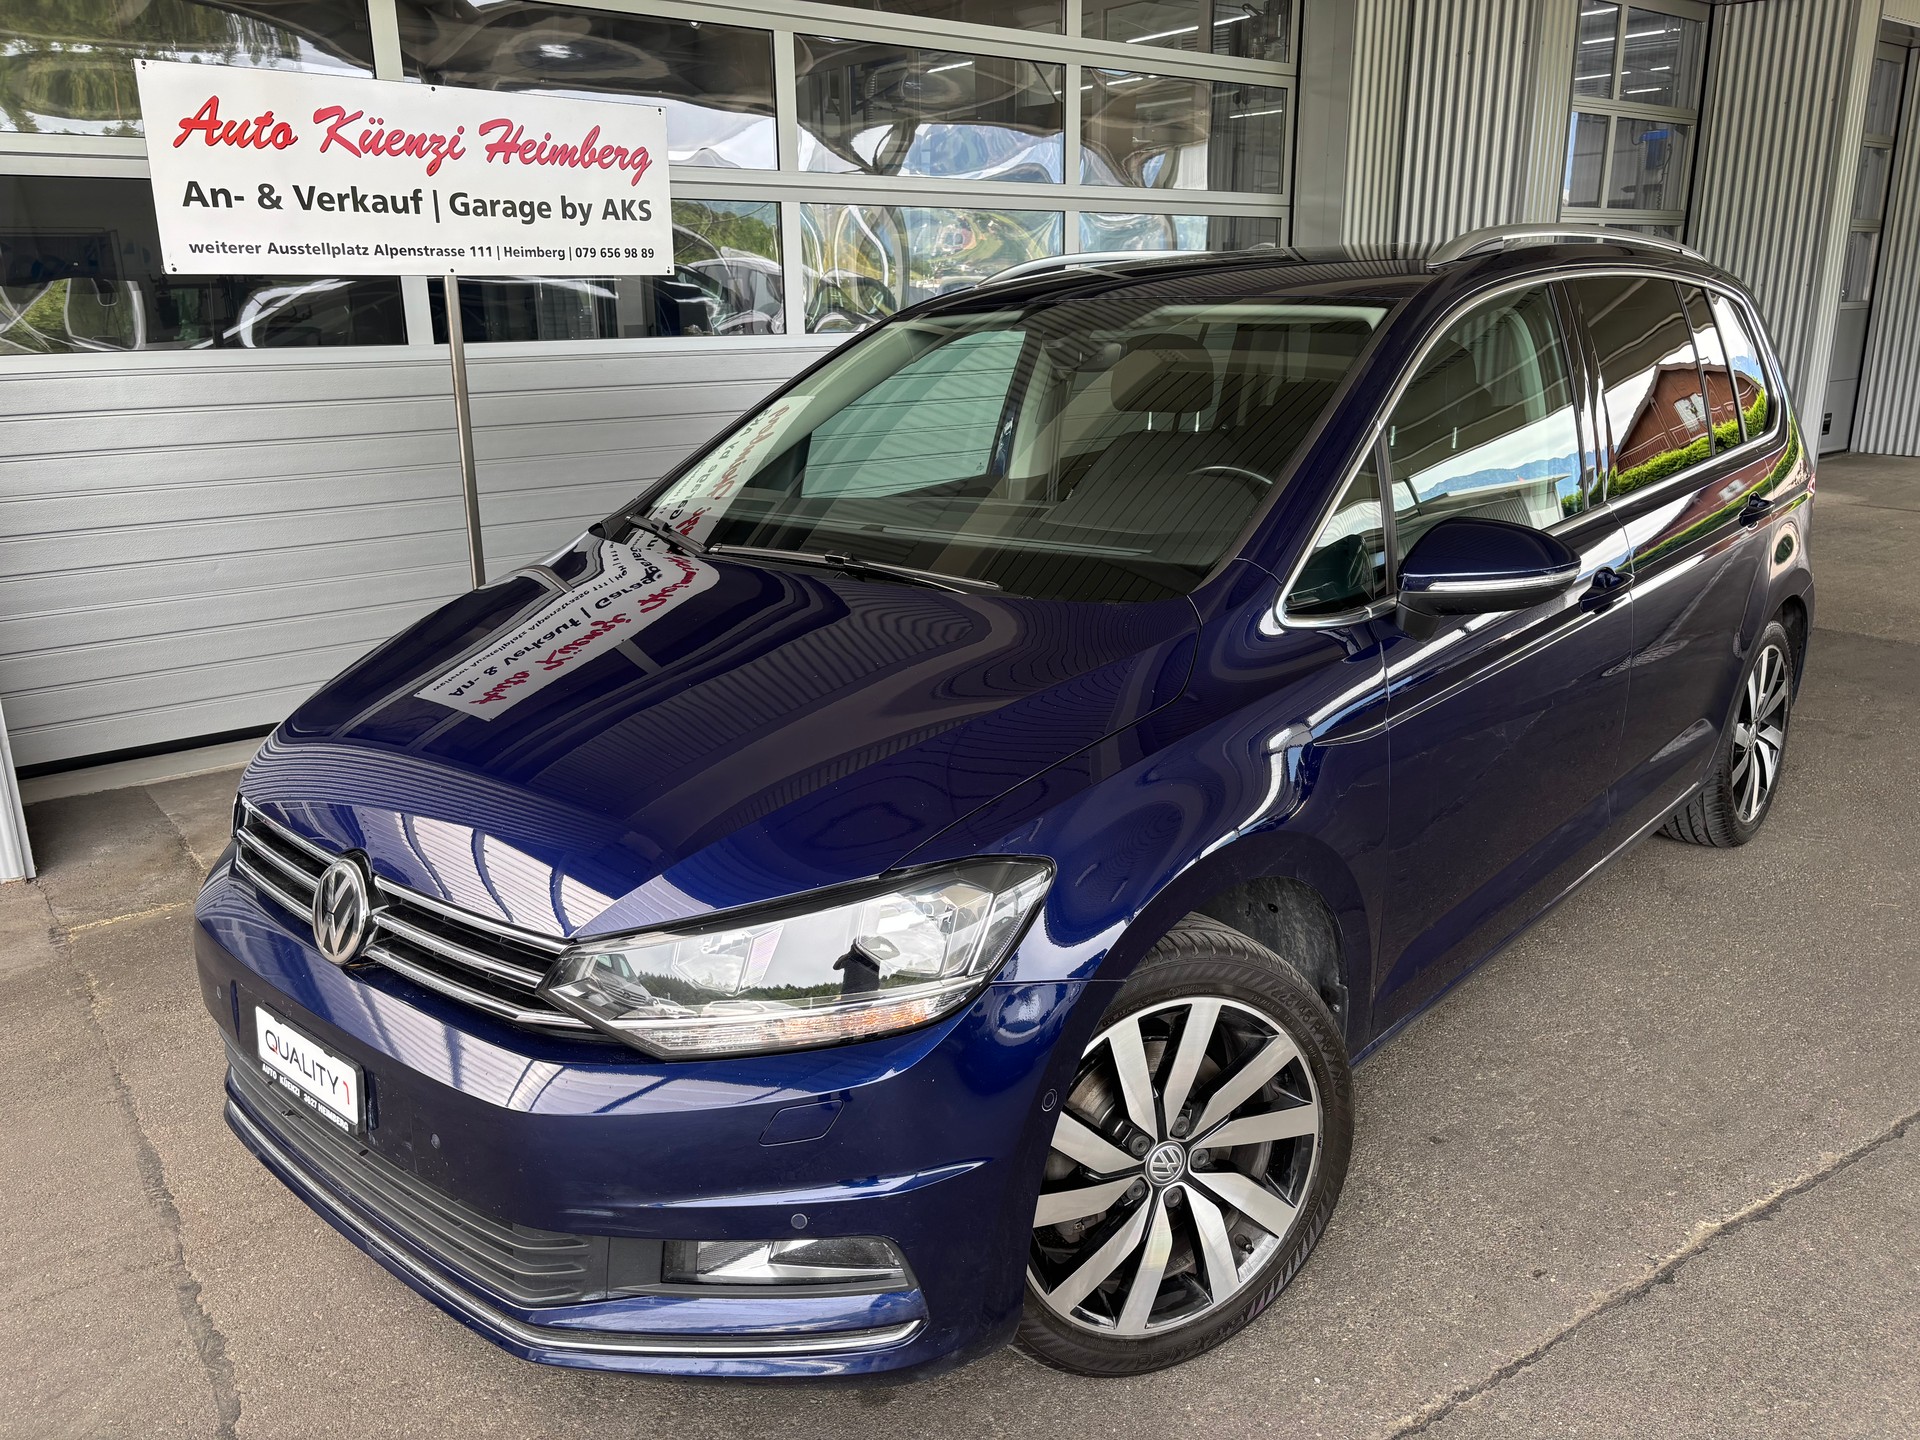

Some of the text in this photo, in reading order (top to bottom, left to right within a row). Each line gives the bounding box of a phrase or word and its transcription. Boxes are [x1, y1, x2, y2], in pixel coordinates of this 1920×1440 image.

[172, 95, 652, 187] Auto Küenzi Heimberg
[182, 180, 245, 209] An-
[257, 183, 284, 210] &
[291, 184, 423, 215] Verkauf
[449, 191, 552, 225] Garage
[560, 195, 593, 227] by
[601, 198, 652, 222] AKS
[188, 240, 262, 254] weiterer
[267, 242, 370, 259] Ausstellplatz
[373, 243, 466, 259] Alpenstrasse
[469, 245, 492, 258] 111
[503, 246, 566, 261] Heimberg
[575, 247, 597, 259] 079
[600, 247, 621, 259] 656
[624, 247, 638, 259] 98
[641, 247, 655, 259] 89
[262, 1063, 277, 1080] AUTO
[318, 1102, 349, 1132] HEIMBERG
